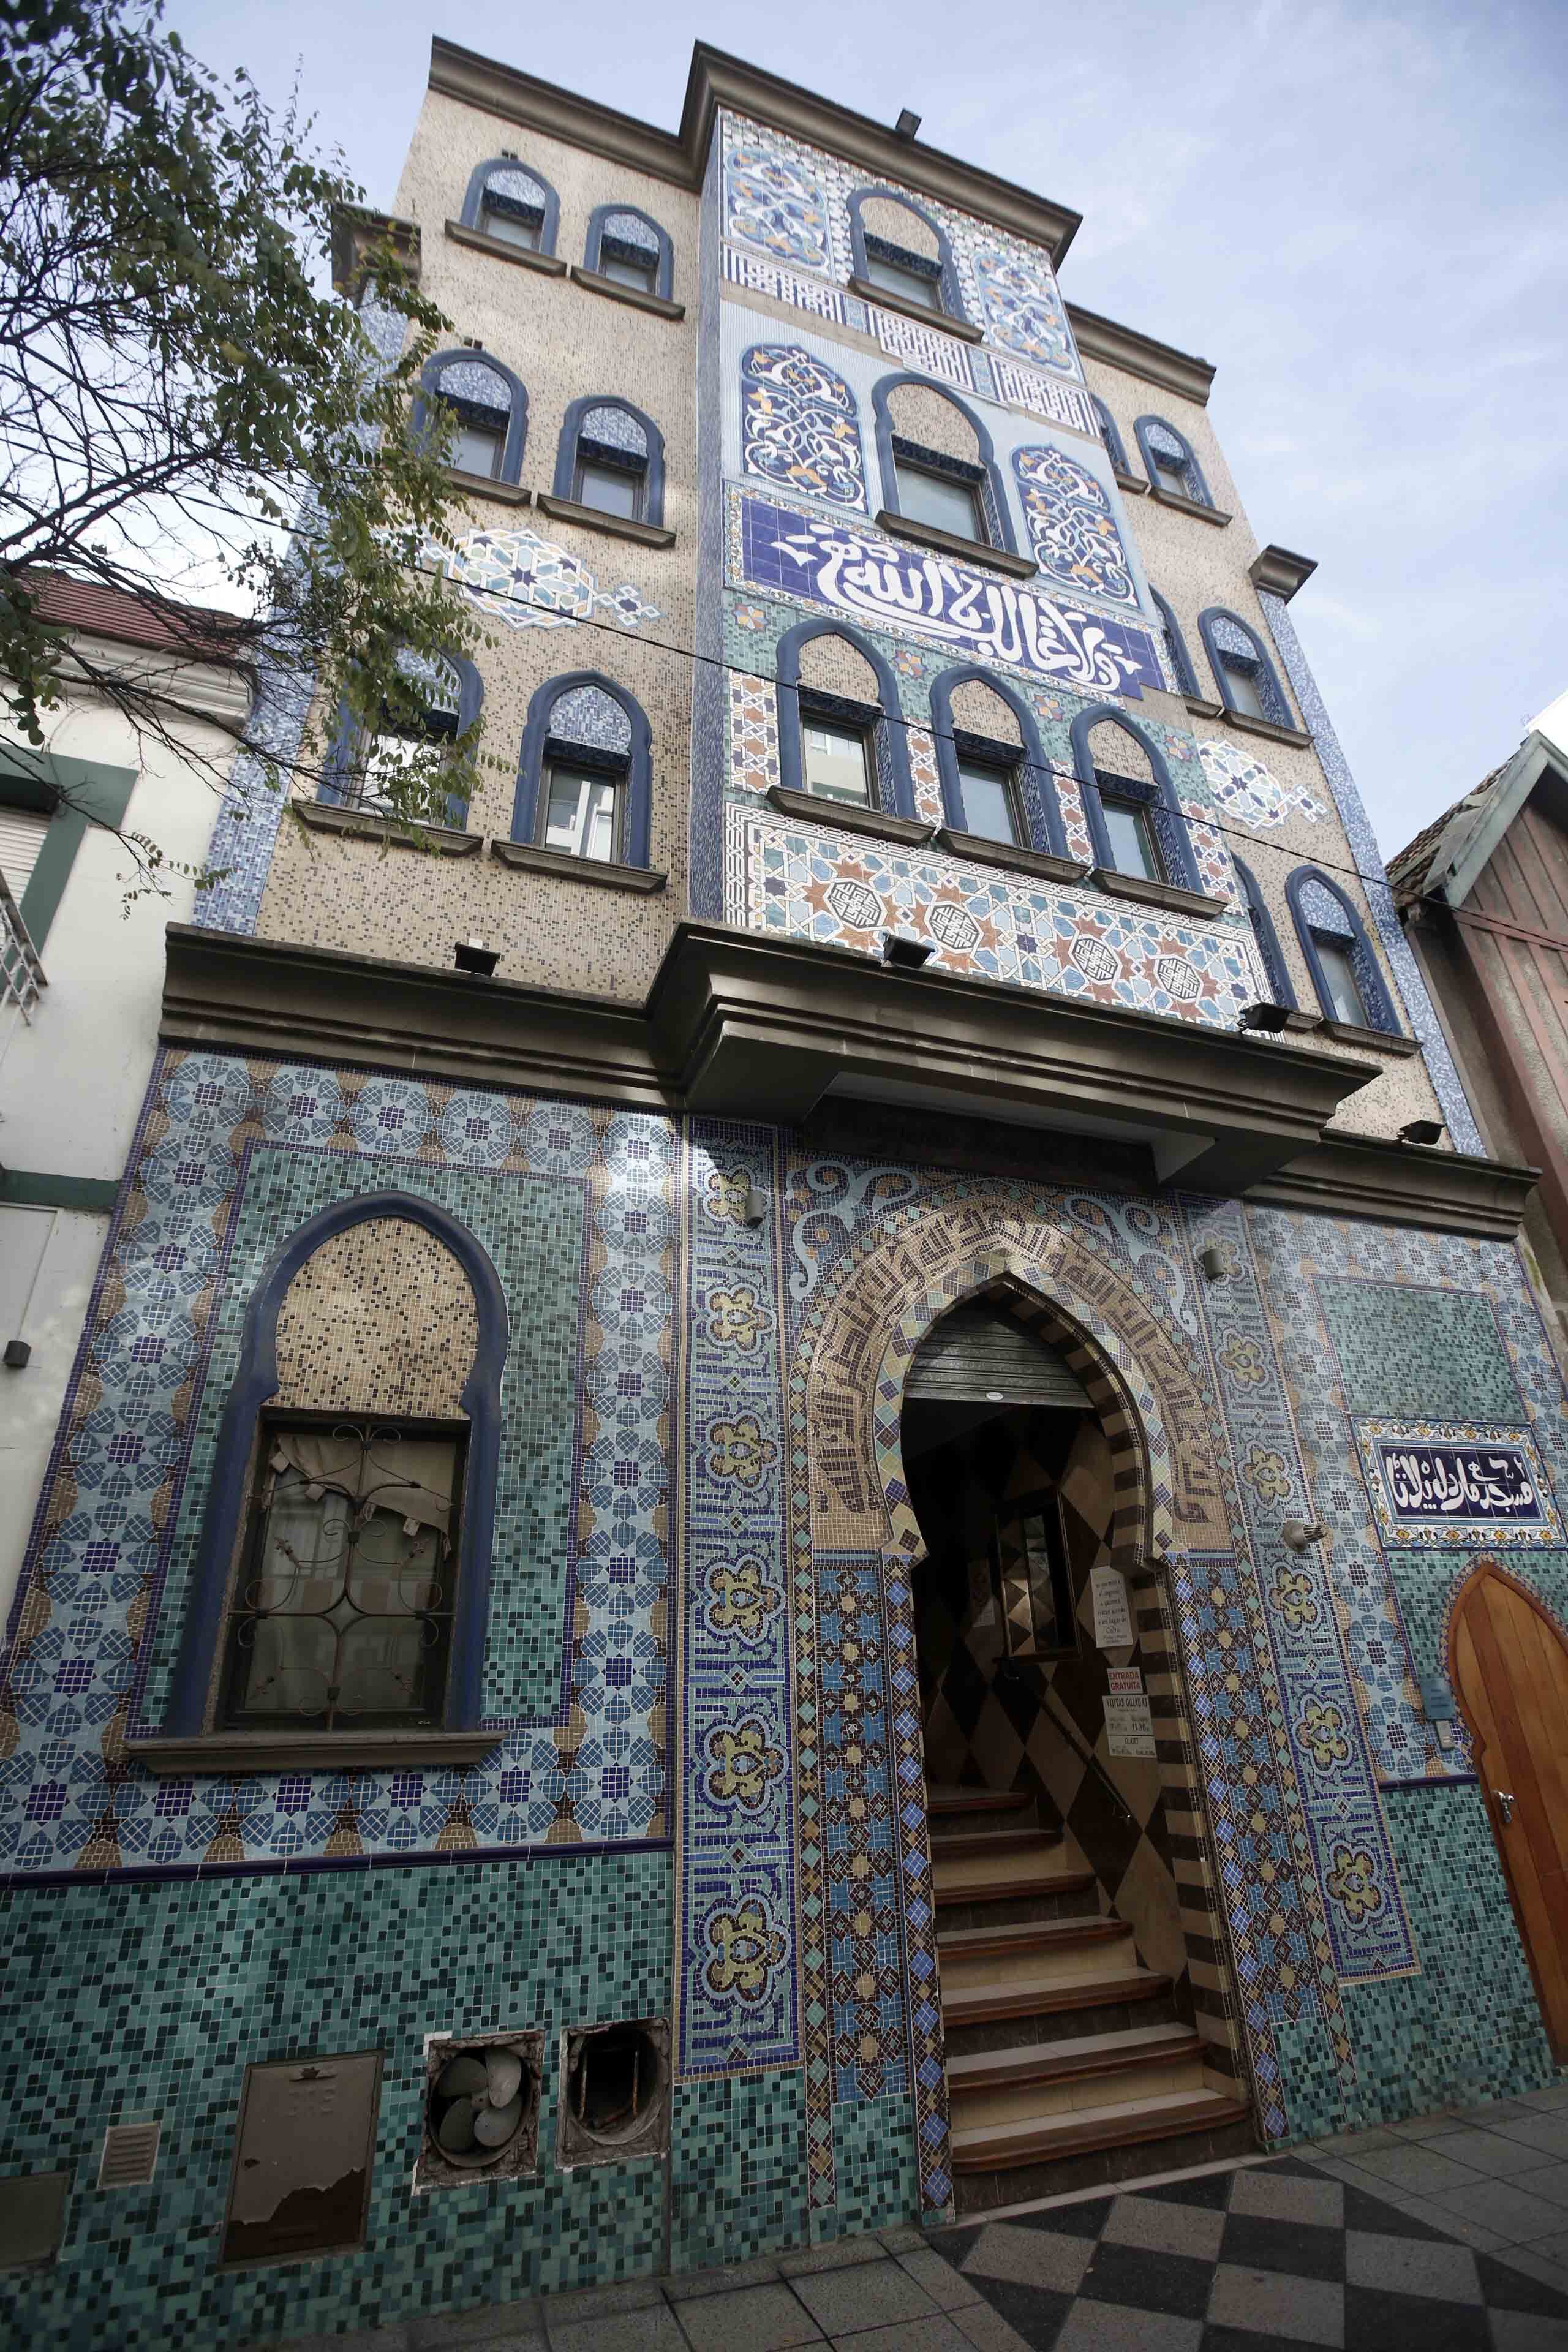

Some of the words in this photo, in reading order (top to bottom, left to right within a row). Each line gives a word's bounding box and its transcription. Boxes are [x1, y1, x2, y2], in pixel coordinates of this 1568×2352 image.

[1109, 1670, 1140, 1680] ENTRADA
[1110, 1681, 1141, 1691] GRATUITA
[1107, 1698, 1124, 1708] VISITAS
[1126, 1697, 1148, 1708] GUIADAS
